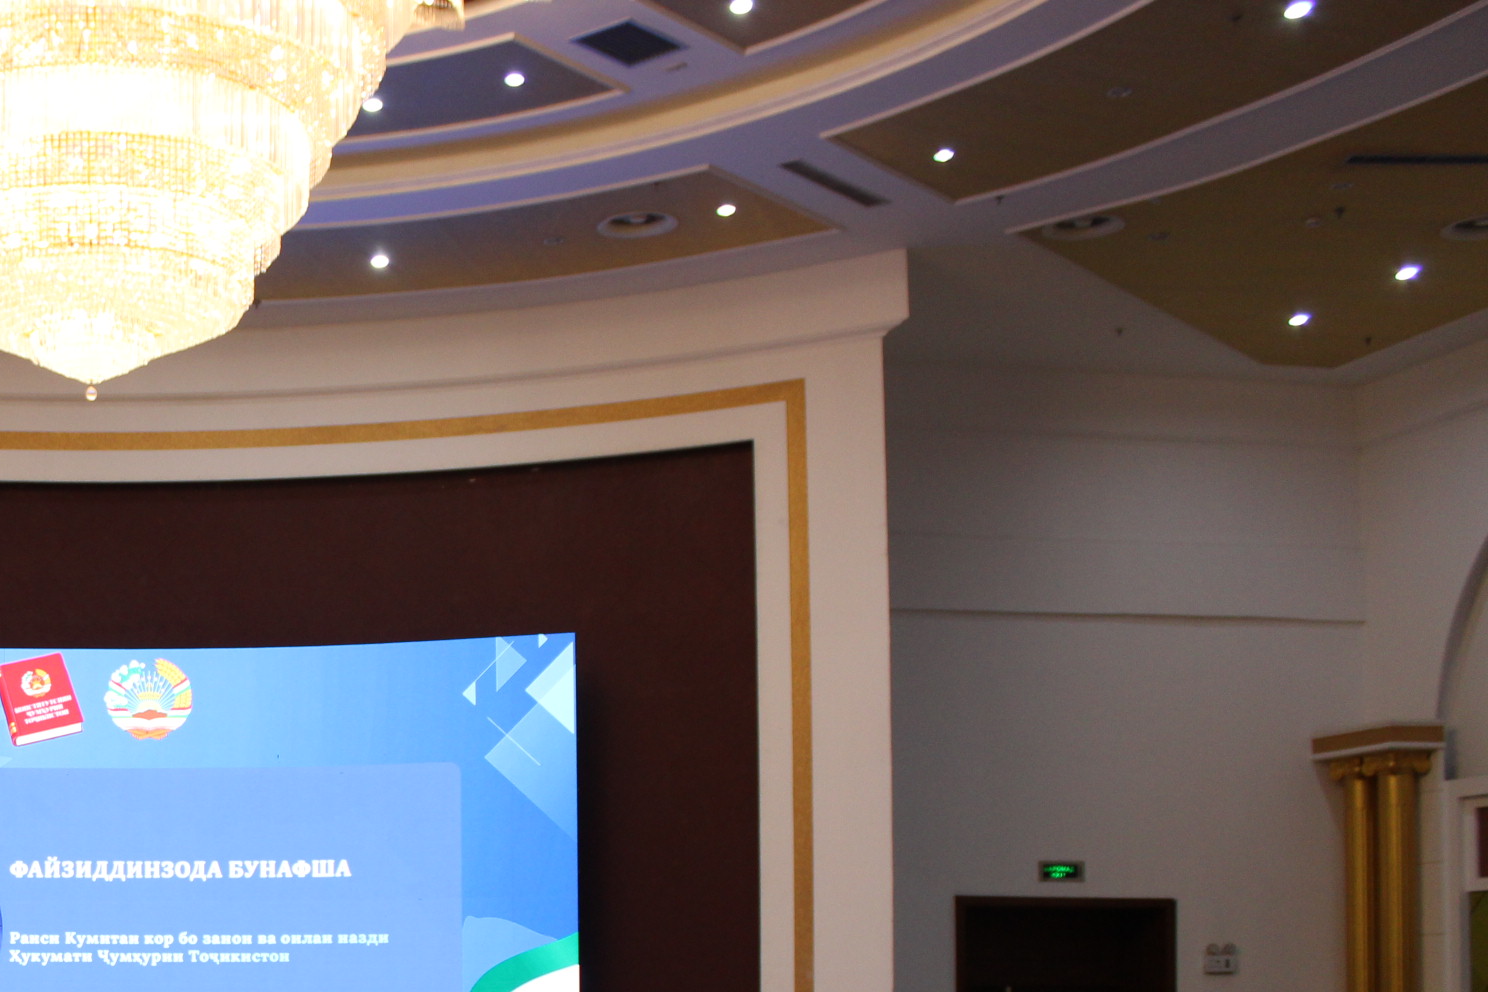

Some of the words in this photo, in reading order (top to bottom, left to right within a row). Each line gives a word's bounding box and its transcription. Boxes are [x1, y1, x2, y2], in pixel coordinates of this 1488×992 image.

[9, 856, 223, 882] ФАЙЗИДДИНЗОДА
[228, 859, 352, 879] БУНАФША
[144, 934, 174, 949] кор
[178, 931, 198, 945] бо
[202, 934, 252, 945] занон
[257, 934, 277, 945] ва
[338, 933, 389, 946] назди
[9, 949, 93, 967] Ҳукумати
[188, 949, 290, 966] Тоҷикистон
